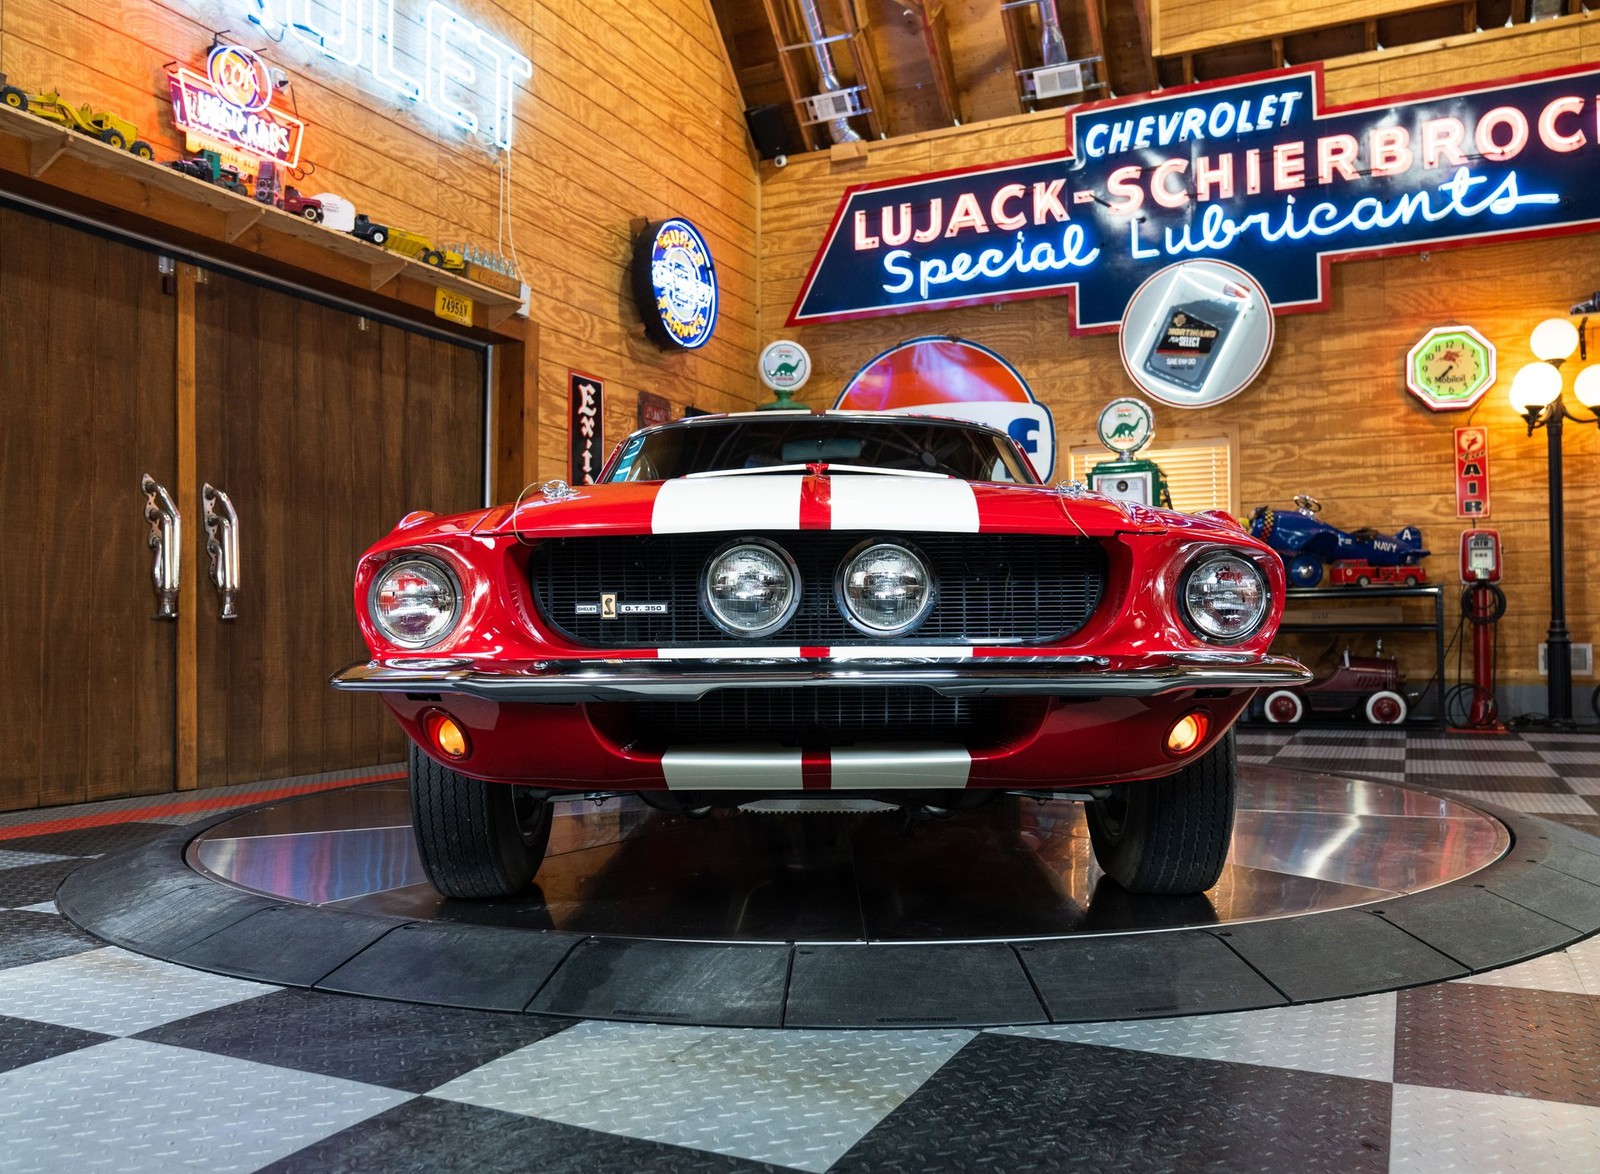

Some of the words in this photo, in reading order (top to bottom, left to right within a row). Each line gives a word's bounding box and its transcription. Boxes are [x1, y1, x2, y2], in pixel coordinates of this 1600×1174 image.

[1085, 91, 1303, 157] CHEVROLET
[854, 94, 1600, 250] LUJACK-SCHIERBROC
[882, 224, 1101, 299] Special
[1131, 167, 1560, 259] Lubricants
[1446, 341, 1454, 349] 12
[1425, 353, 1434, 361] 10
[1434, 374, 1466, 384] Mobiloil
[1462, 463, 1484, 513] AIR
[1402, 529, 1412, 541] A
[1373, 540, 1397, 553] NAVY
